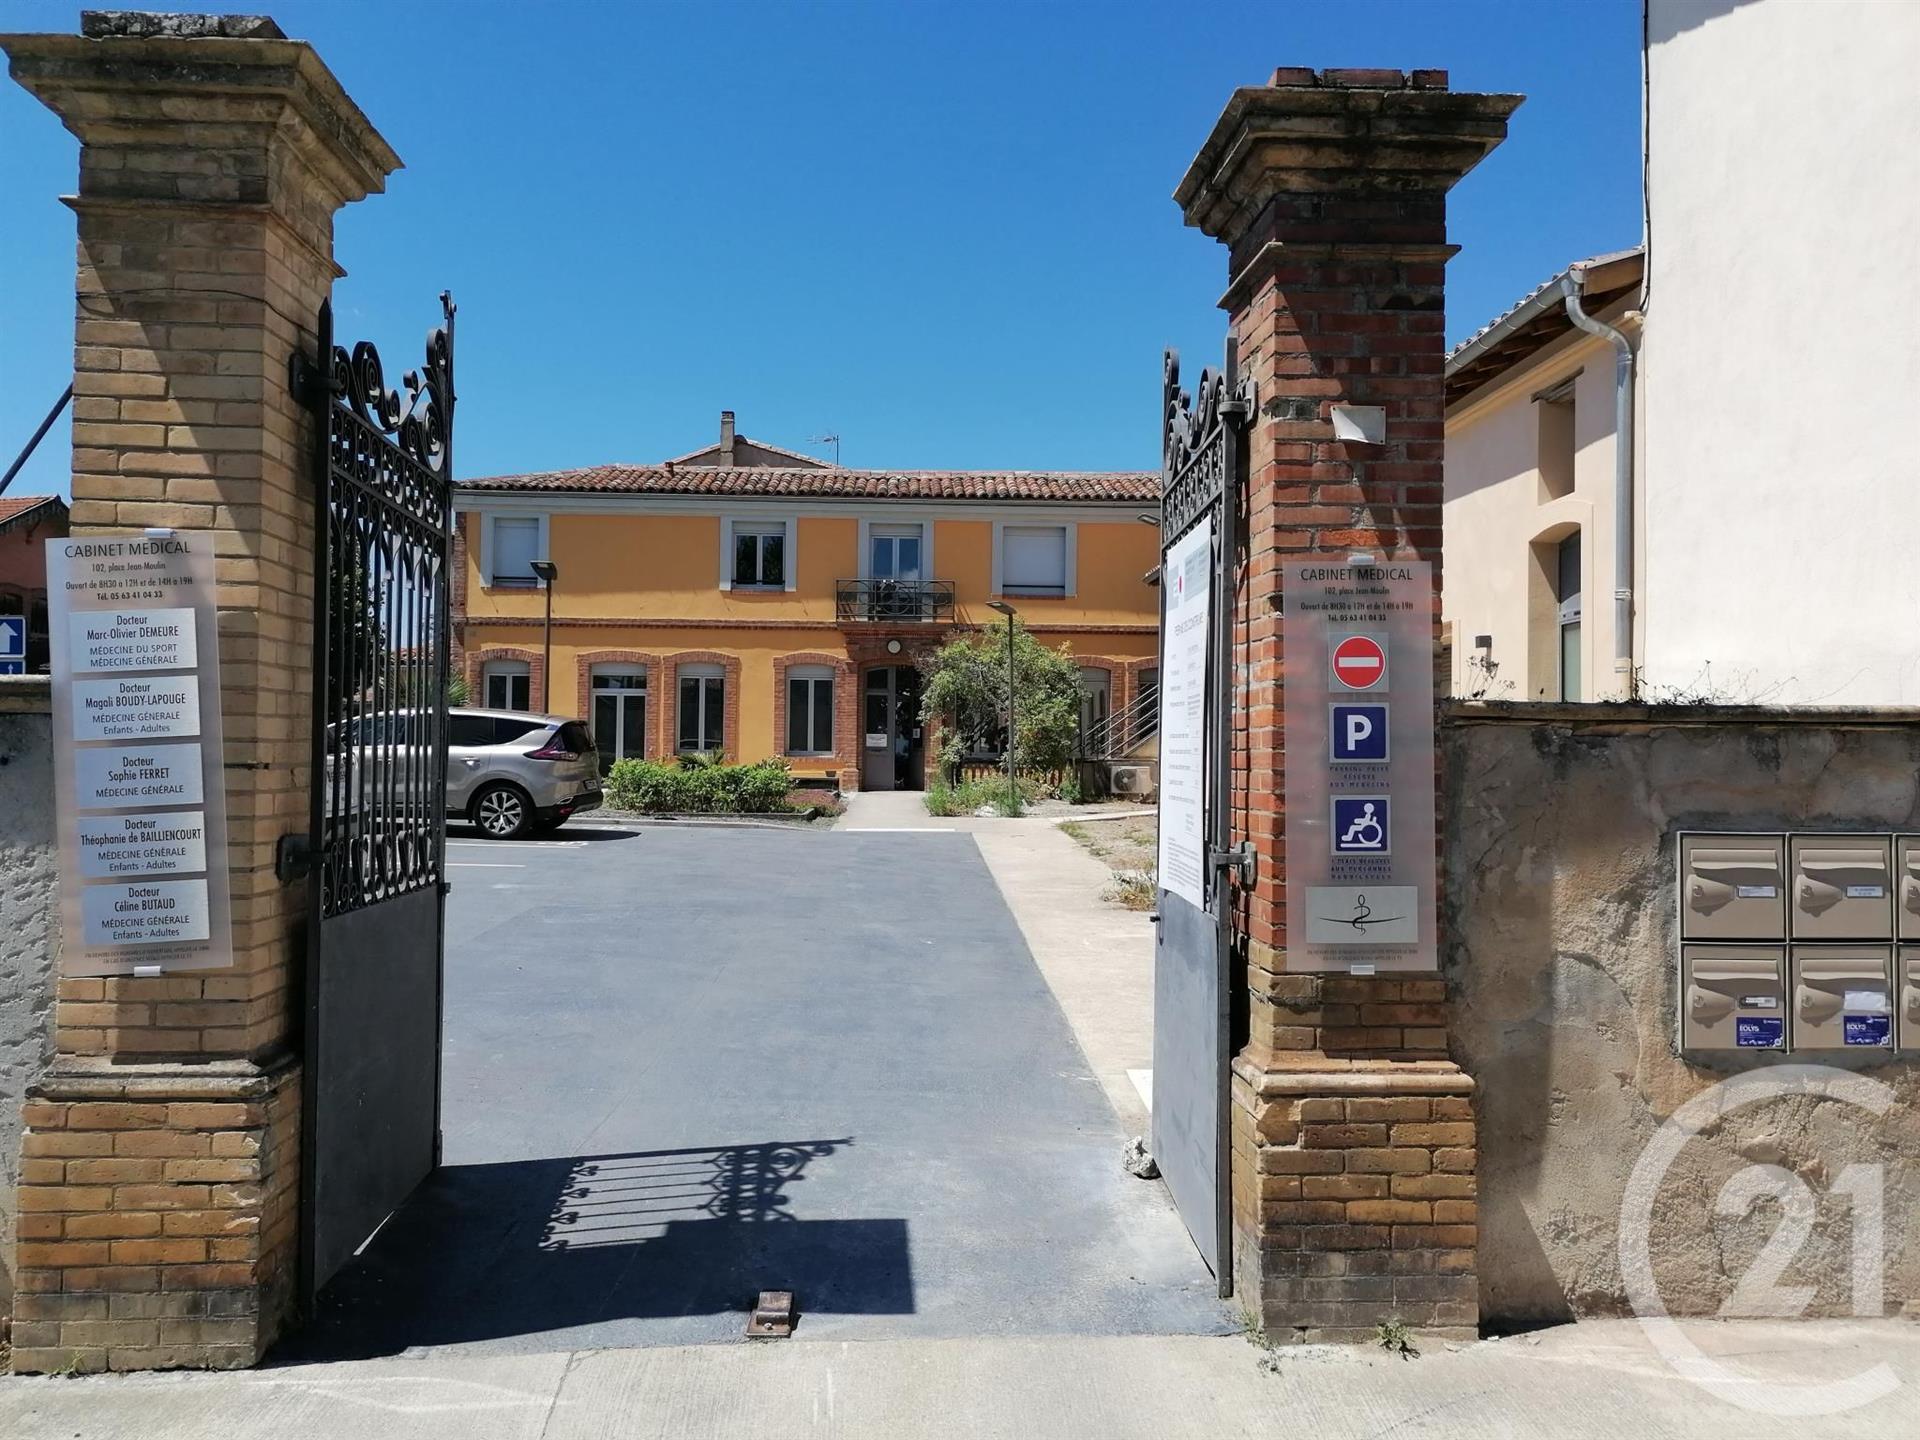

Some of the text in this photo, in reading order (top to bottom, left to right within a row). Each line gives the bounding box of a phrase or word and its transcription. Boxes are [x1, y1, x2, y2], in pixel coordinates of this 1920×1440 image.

[64, 541, 191, 558] CABINET MEDICAL
[92, 564, 106, 572] 102,
[108, 562, 125, 573] place
[1300, 568, 1413, 580] CABINET MEDICAL
[66, 581, 88, 590] Ouvert
[89, 580, 97, 588] de
[98, 580, 116, 588] 8H30
[125, 578, 138, 587] 12H
[148, 578, 156, 586] de
[158, 577, 172, 586] 14H
[180, 576, 193, 585] 19H
[1339, 586, 1354, 596] place
[1300, 602, 1320, 610] Ouvert
[117, 615, 147, 625] Docteur
[87, 626, 178, 640] Marc-Olivier DEMEURE
[90, 644, 177, 656] MÉDECINE DU SPORT
[90, 655, 178, 668] MÉDECINE GÉNÉRALE
[120, 683, 150, 693] Docteur
[86, 693, 186, 710] Magali BOUDY-LAPOUGE
[104, 726, 133, 735] Enfants
[140, 724, 170, 733] Adultes
[1348, 714, 1372, 750] P
[122, 756, 154, 768] Docteur
[108, 768, 170, 783] Sophie FERRET
[96, 784, 184, 798] MÉDECINE GÉNÉRALE
[126, 820, 156, 830] Docteur
[80, 828, 202, 847] Théophanie de BAILLIENCOURT
[98, 847, 186, 860] MÉDECINE GÉNÉRALE
[110, 862, 139, 872] Enfants
[146, 860, 176, 869] Adultes
[129, 888, 160, 898] Docteur
[114, 898, 176, 912] Céline BUTAUD
[102, 914, 190, 928] MÉDECINE GÉNÉRALE
[113, 930, 142, 940] Enfants
[150, 928, 180, 938] Adultes
